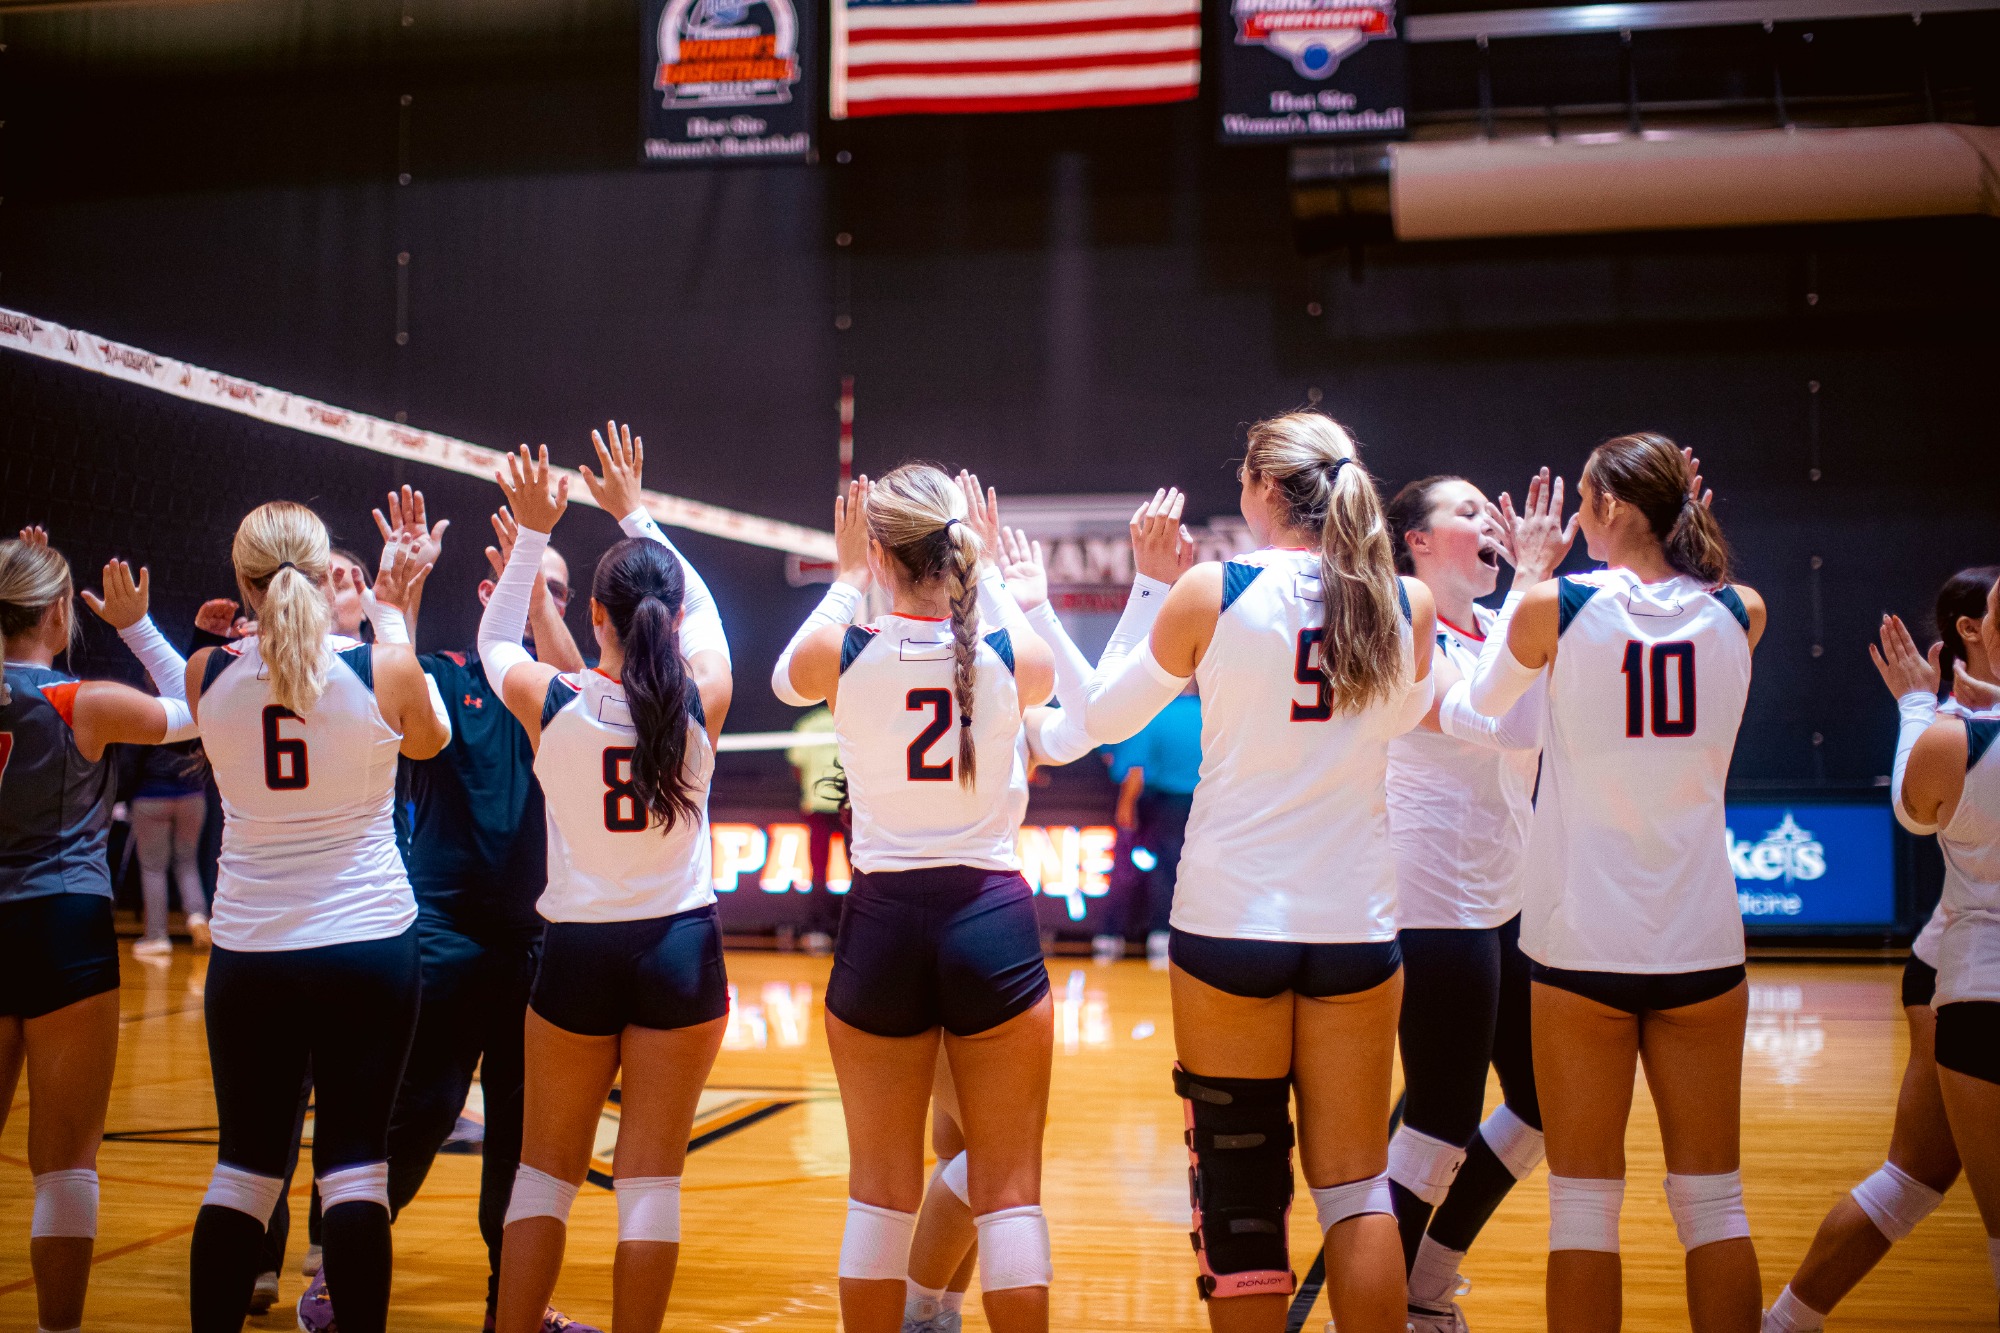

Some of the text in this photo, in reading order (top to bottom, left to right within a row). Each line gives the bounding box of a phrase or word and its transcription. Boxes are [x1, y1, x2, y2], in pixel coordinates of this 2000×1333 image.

[1290, 627, 1335, 722] 5
[1621, 640, 1697, 738] 10
[262, 704, 309, 791] 6
[906, 687, 953, 781] 2
[602, 746, 649, 833] 8
[1237, 1278, 1283, 1288] DONJOY
